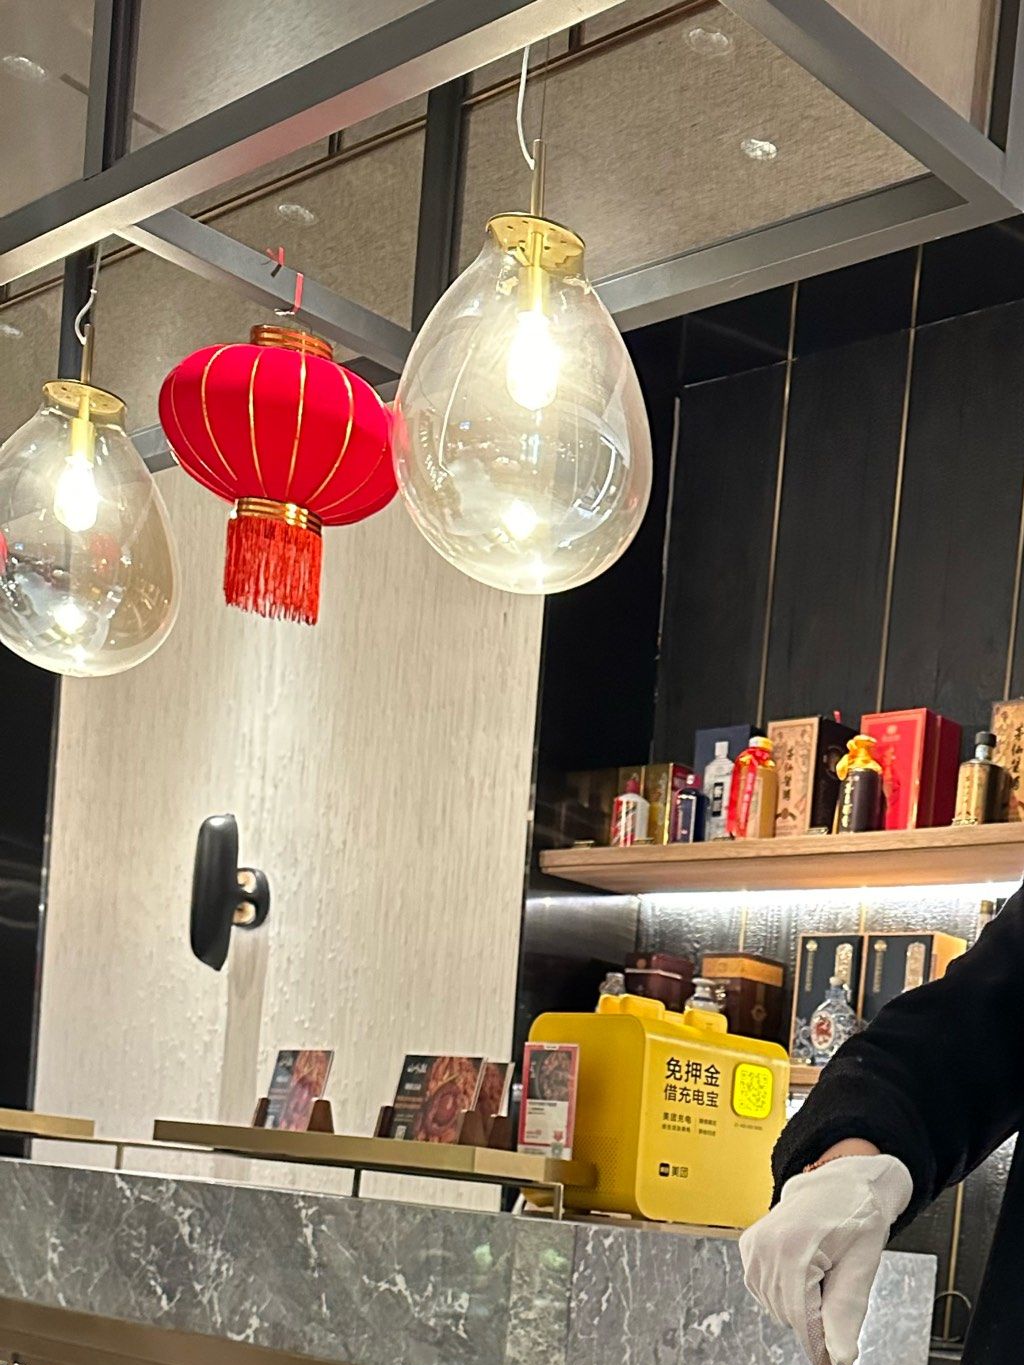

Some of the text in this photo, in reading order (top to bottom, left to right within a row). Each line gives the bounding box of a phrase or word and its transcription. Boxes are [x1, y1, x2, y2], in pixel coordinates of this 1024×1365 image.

[665, 1057, 720, 1087] 免押金
[663, 1083, 719, 1108] 借充电宝
